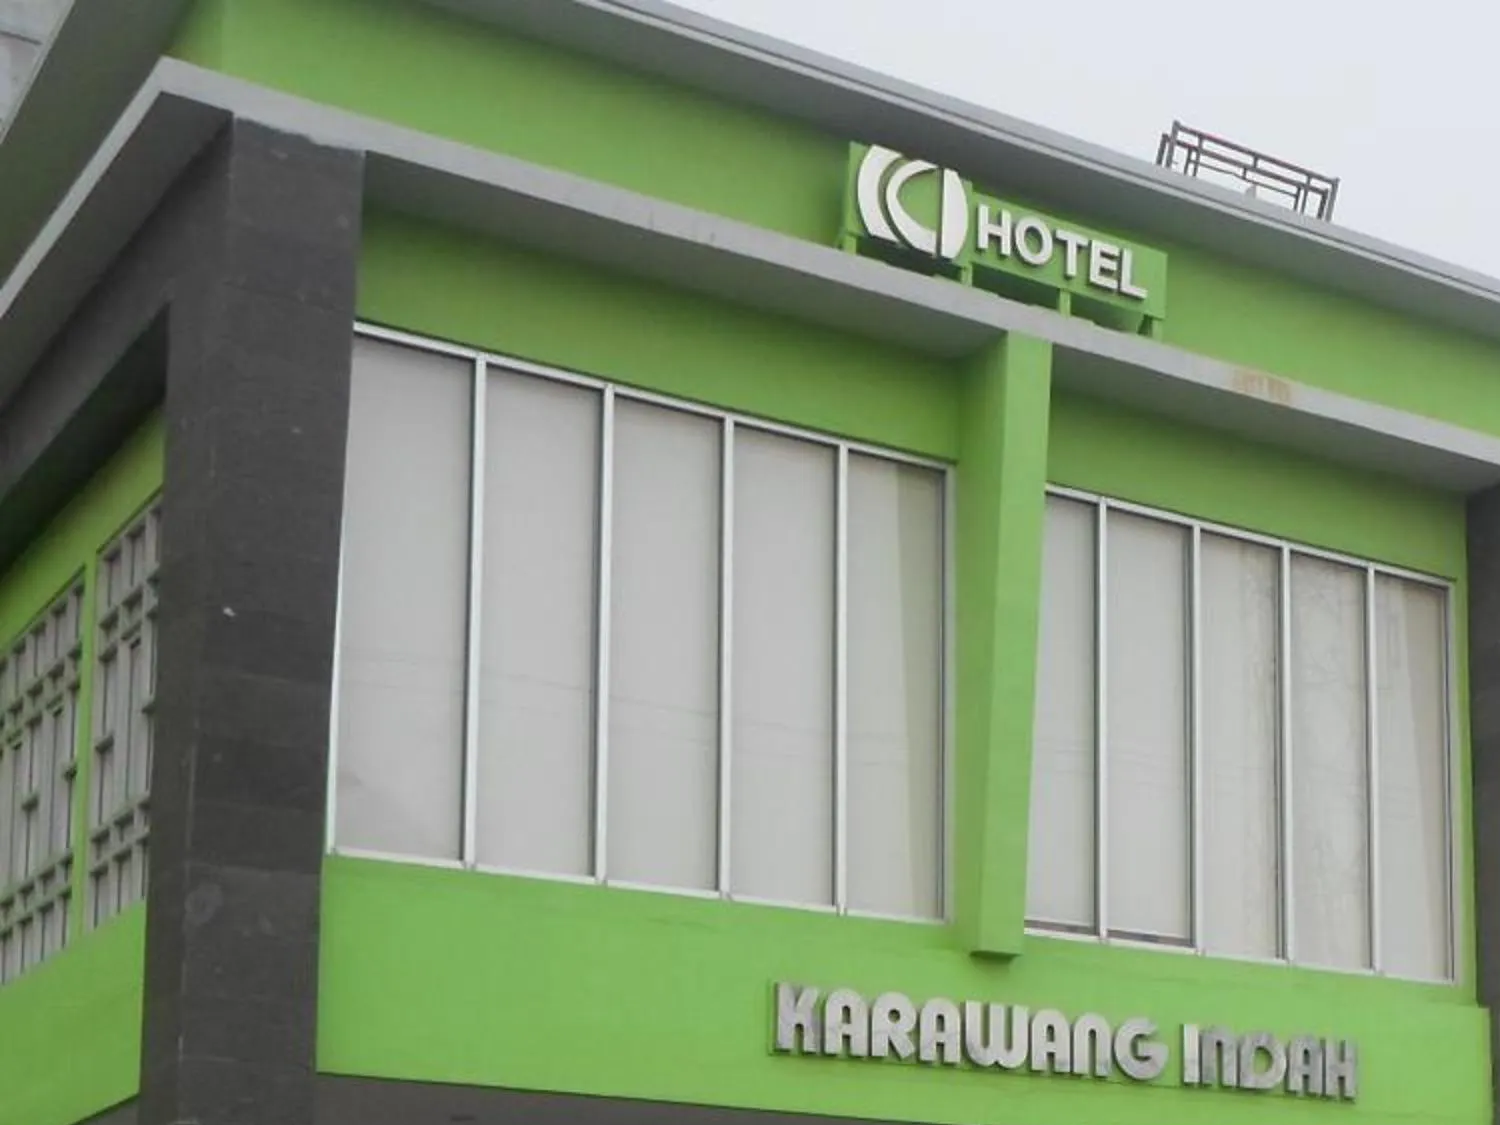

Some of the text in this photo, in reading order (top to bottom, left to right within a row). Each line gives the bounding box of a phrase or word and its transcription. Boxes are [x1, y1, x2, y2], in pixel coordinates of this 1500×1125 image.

[977, 204, 1148, 300] HOTEL
[773, 981, 1357, 1102] KARAWANG INDAH
